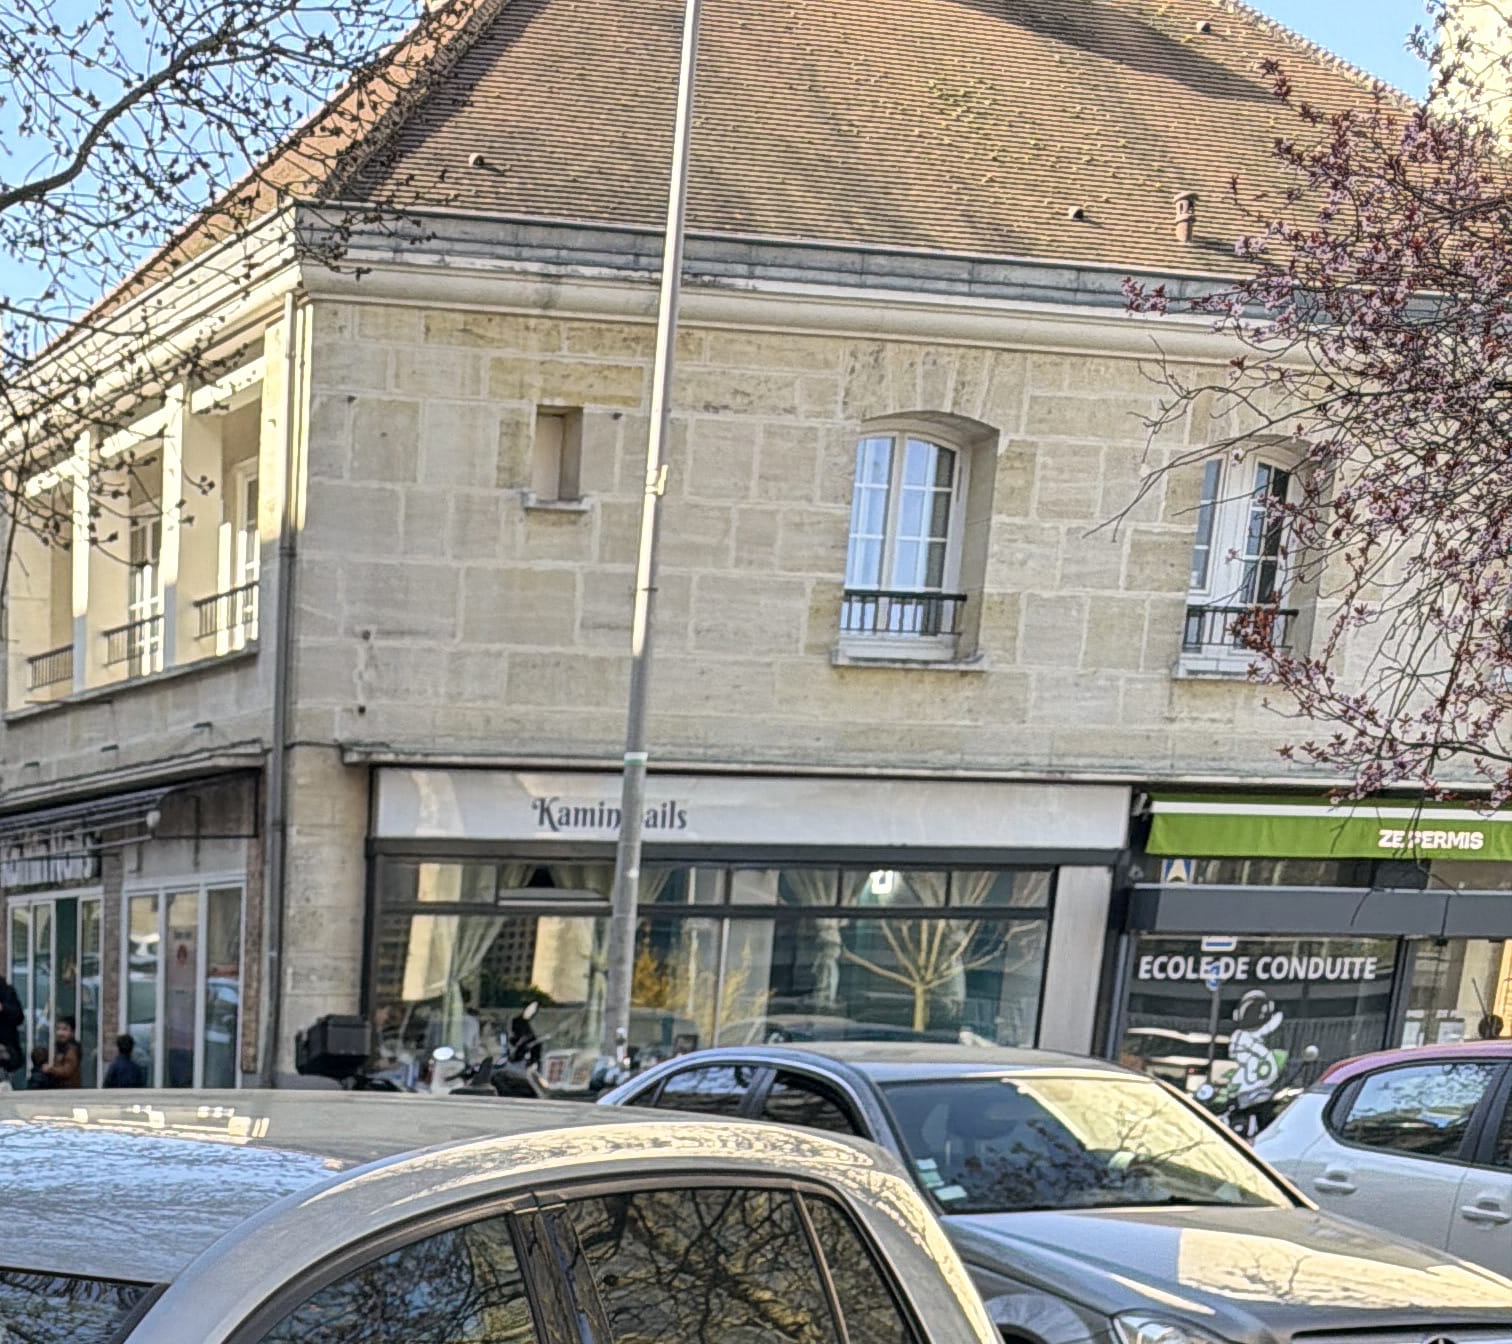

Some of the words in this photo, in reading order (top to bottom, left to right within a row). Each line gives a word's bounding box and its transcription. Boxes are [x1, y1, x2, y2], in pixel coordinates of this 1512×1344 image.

[1138, 955, 1217, 980] ECOLE
[1218, 956, 1251, 980] DE
[1255, 955, 1378, 980] CONDUITE
